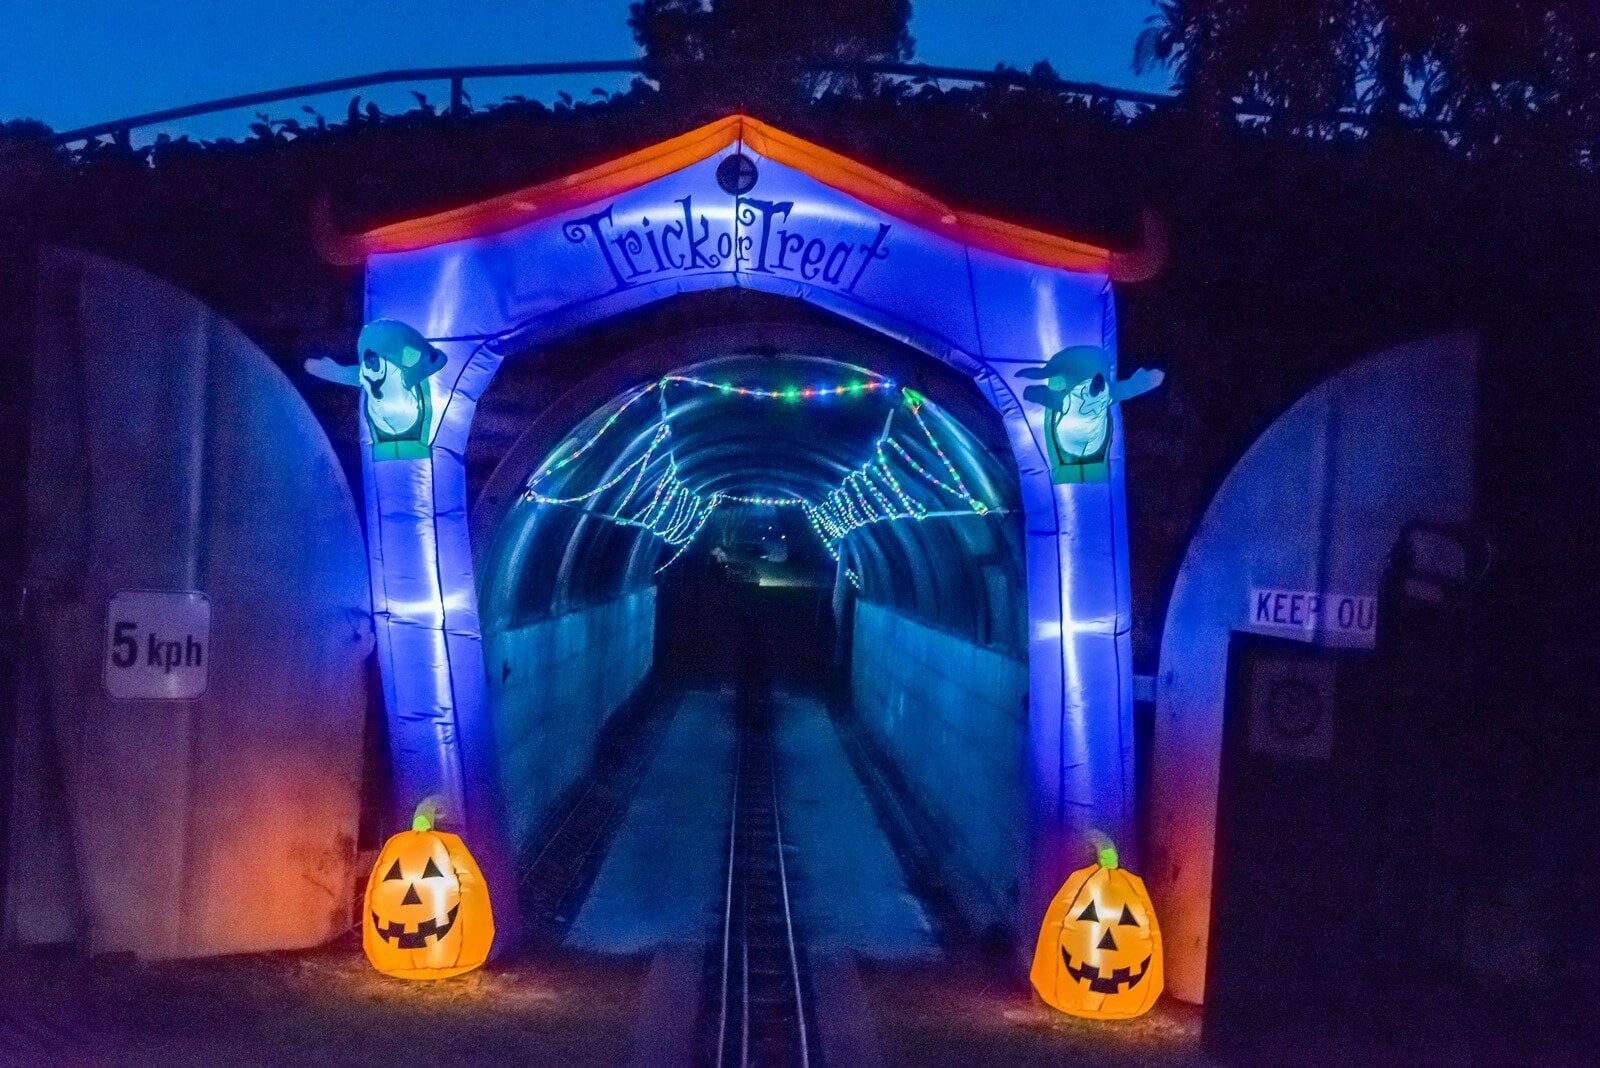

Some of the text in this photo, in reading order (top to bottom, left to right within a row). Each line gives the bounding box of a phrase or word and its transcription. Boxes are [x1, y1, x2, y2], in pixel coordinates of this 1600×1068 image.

[562, 195, 891, 294] Trick or Treat
[1337, 598, 1375, 630] OU
[112, 621, 201, 674] 5 kph
